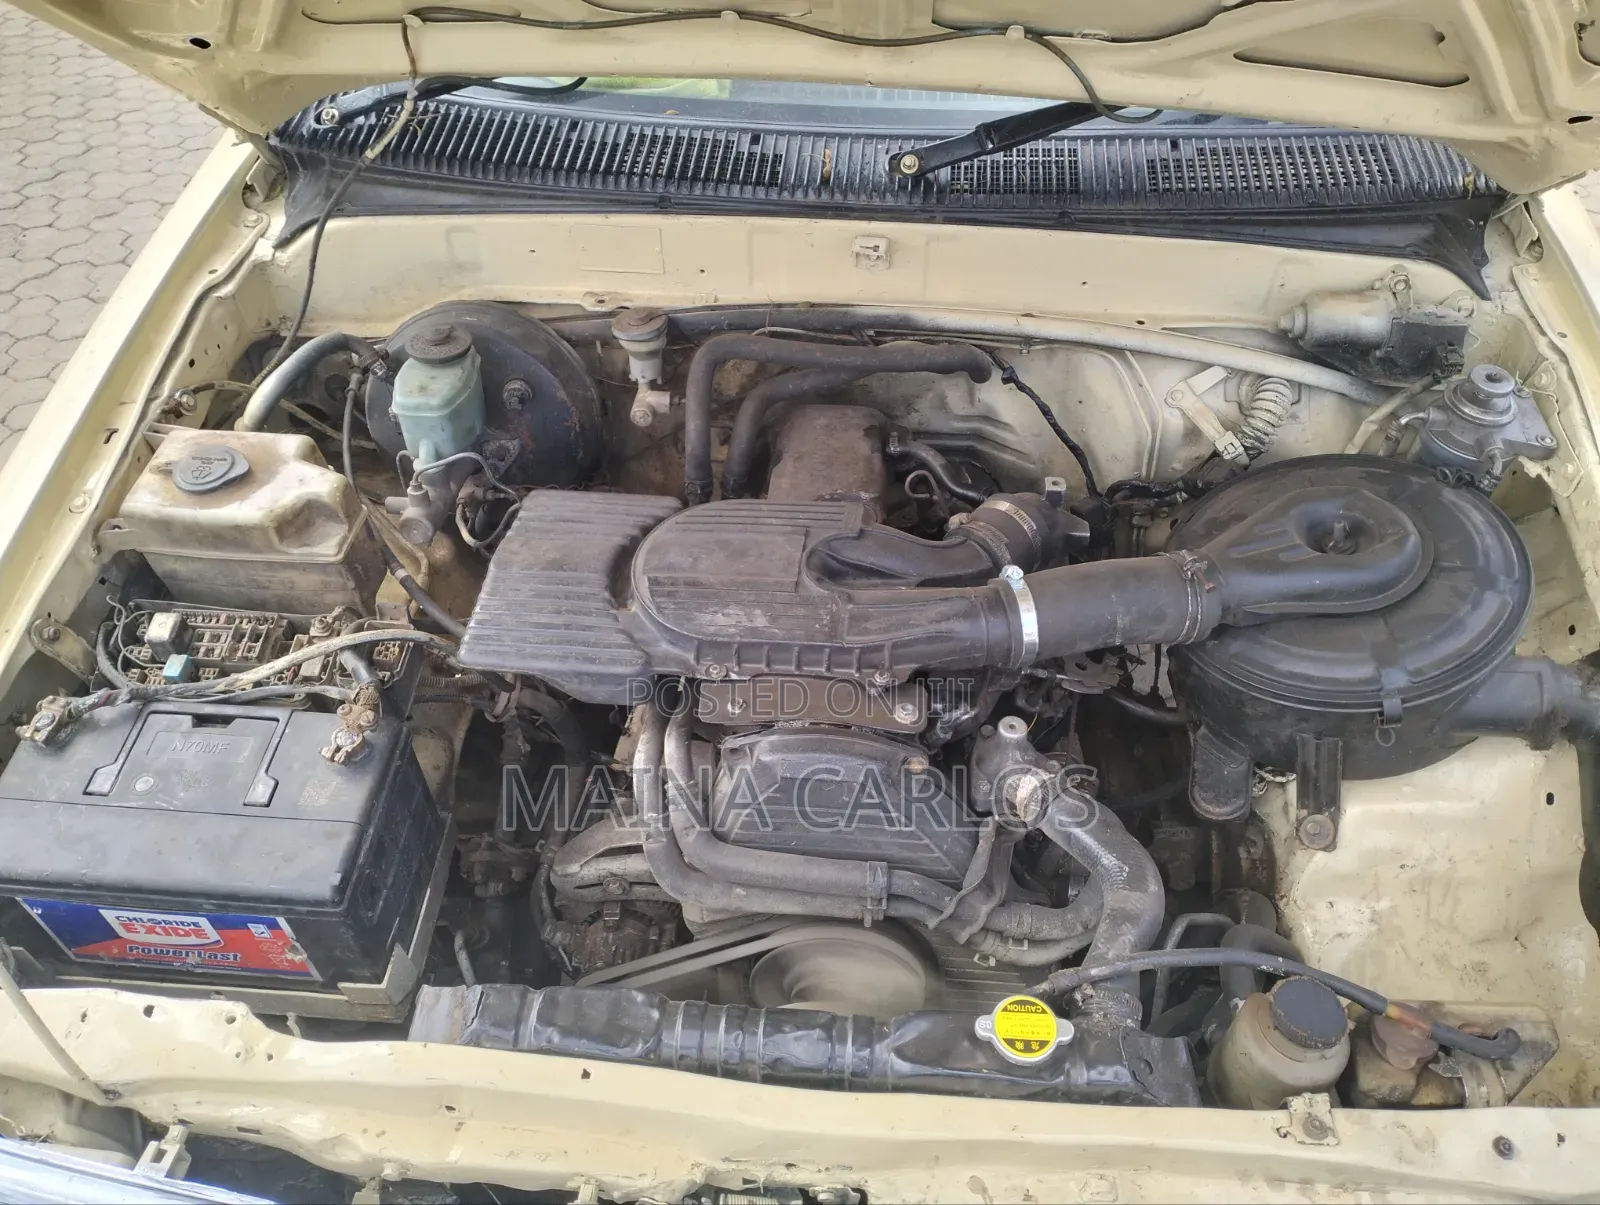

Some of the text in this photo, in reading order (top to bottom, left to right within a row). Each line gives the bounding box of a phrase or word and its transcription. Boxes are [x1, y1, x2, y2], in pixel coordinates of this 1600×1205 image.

[172, 739, 231, 754] N70MF
[115, 915, 201, 928] CHLORIDE
[119, 922, 211, 940] EXIDE
[1006, 1003, 1042, 1013] CAUTION
